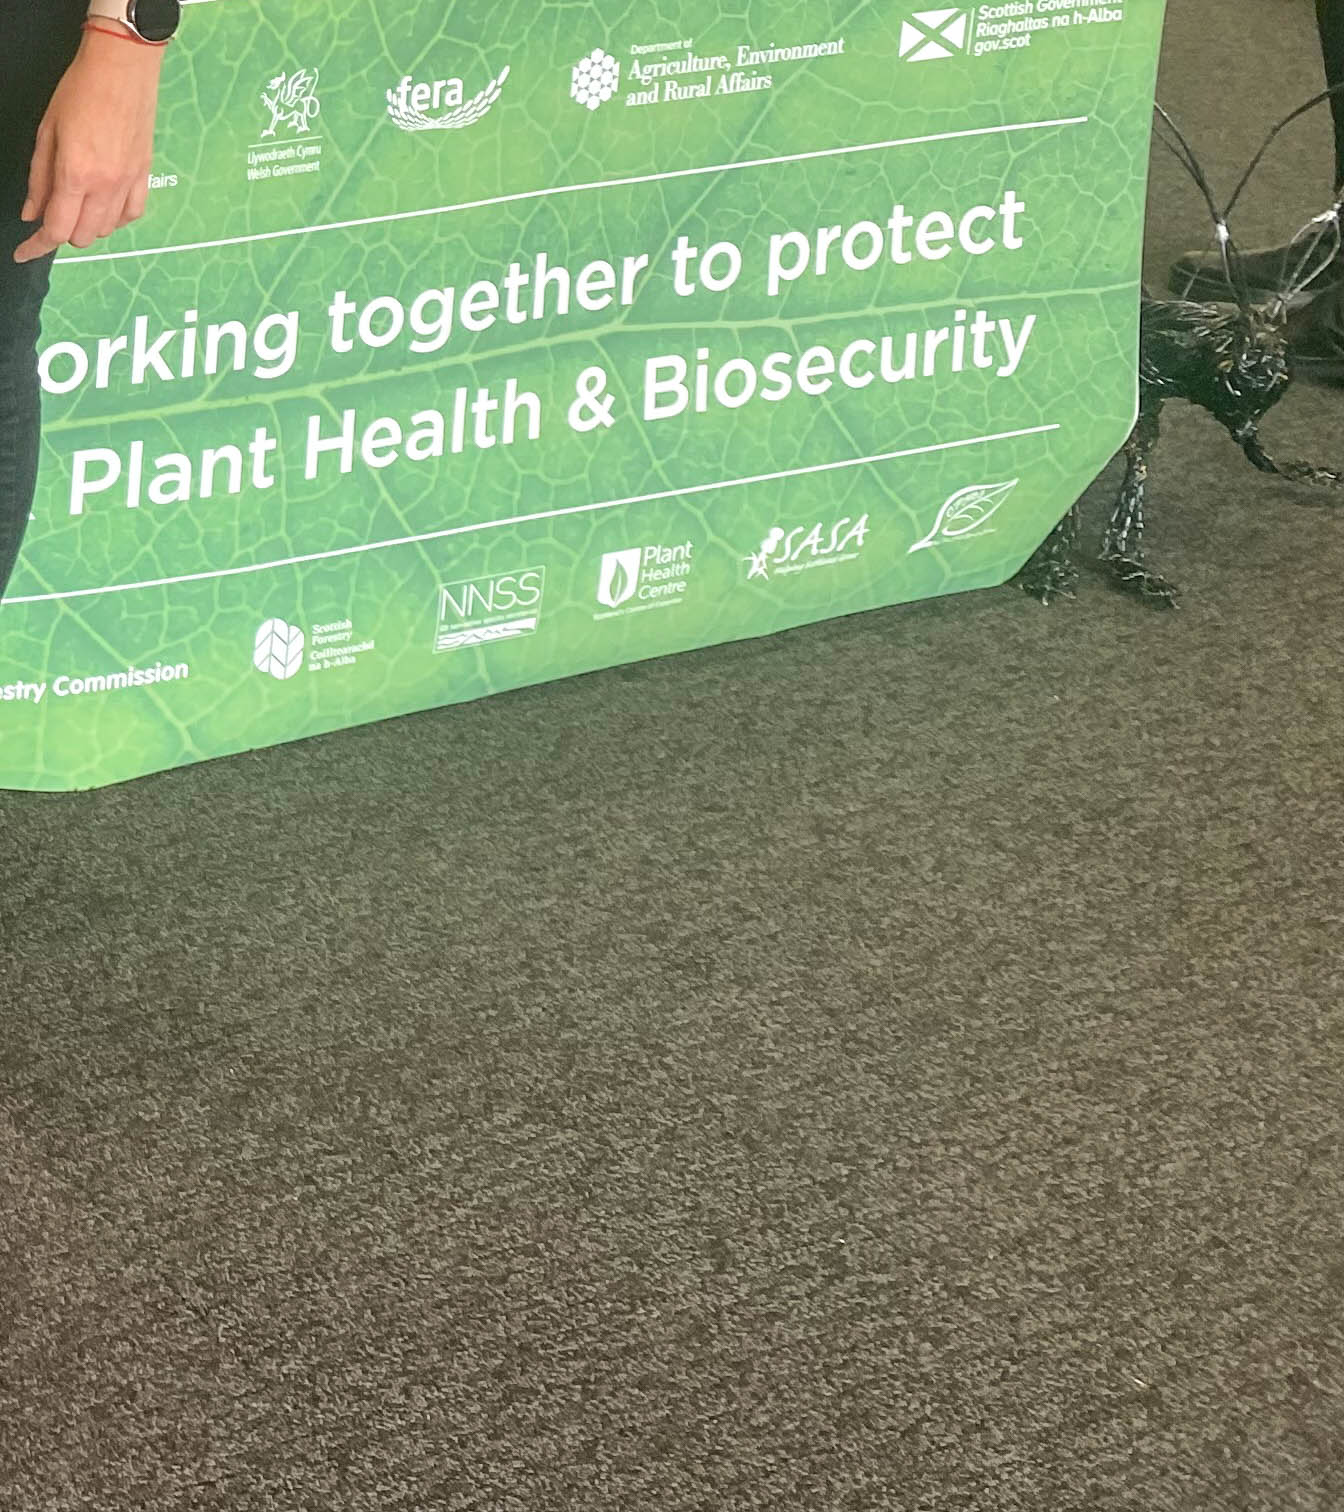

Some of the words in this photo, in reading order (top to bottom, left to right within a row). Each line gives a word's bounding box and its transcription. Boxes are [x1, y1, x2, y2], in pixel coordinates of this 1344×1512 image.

[975, 16, 1049, 38] Riaghaltas
[1052, 14, 1070, 27] na
[1073, 8, 1123, 25] h-Alba
[978, 0, 1034, 20] Scottish
[627, 52, 731, 85] Agriculture,
[736, 37, 845, 67] Environment
[974, 33, 1031, 56] gov.scot
[396, 75, 464, 111] fera
[625, 86, 659, 106] and
[663, 75, 712, 102] Rural
[715, 70, 772, 96] Affairs
[328, 252, 649, 353] together
[672, 236, 742, 296] to
[767, 190, 1025, 296] protect
[70, 427, 277, 515] Plant
[305, 378, 540, 479] Health
[568, 366, 615, 432] &
[643, 309, 1036, 421] Biosecurity
[643, 540, 693, 566] Plant
[773, 513, 871, 563] SASA
[641, 561, 690, 583] Health
[439, 572, 541, 622] NNSS
[638, 580, 687, 600] Centre
[52, 662, 188, 697] Commission
